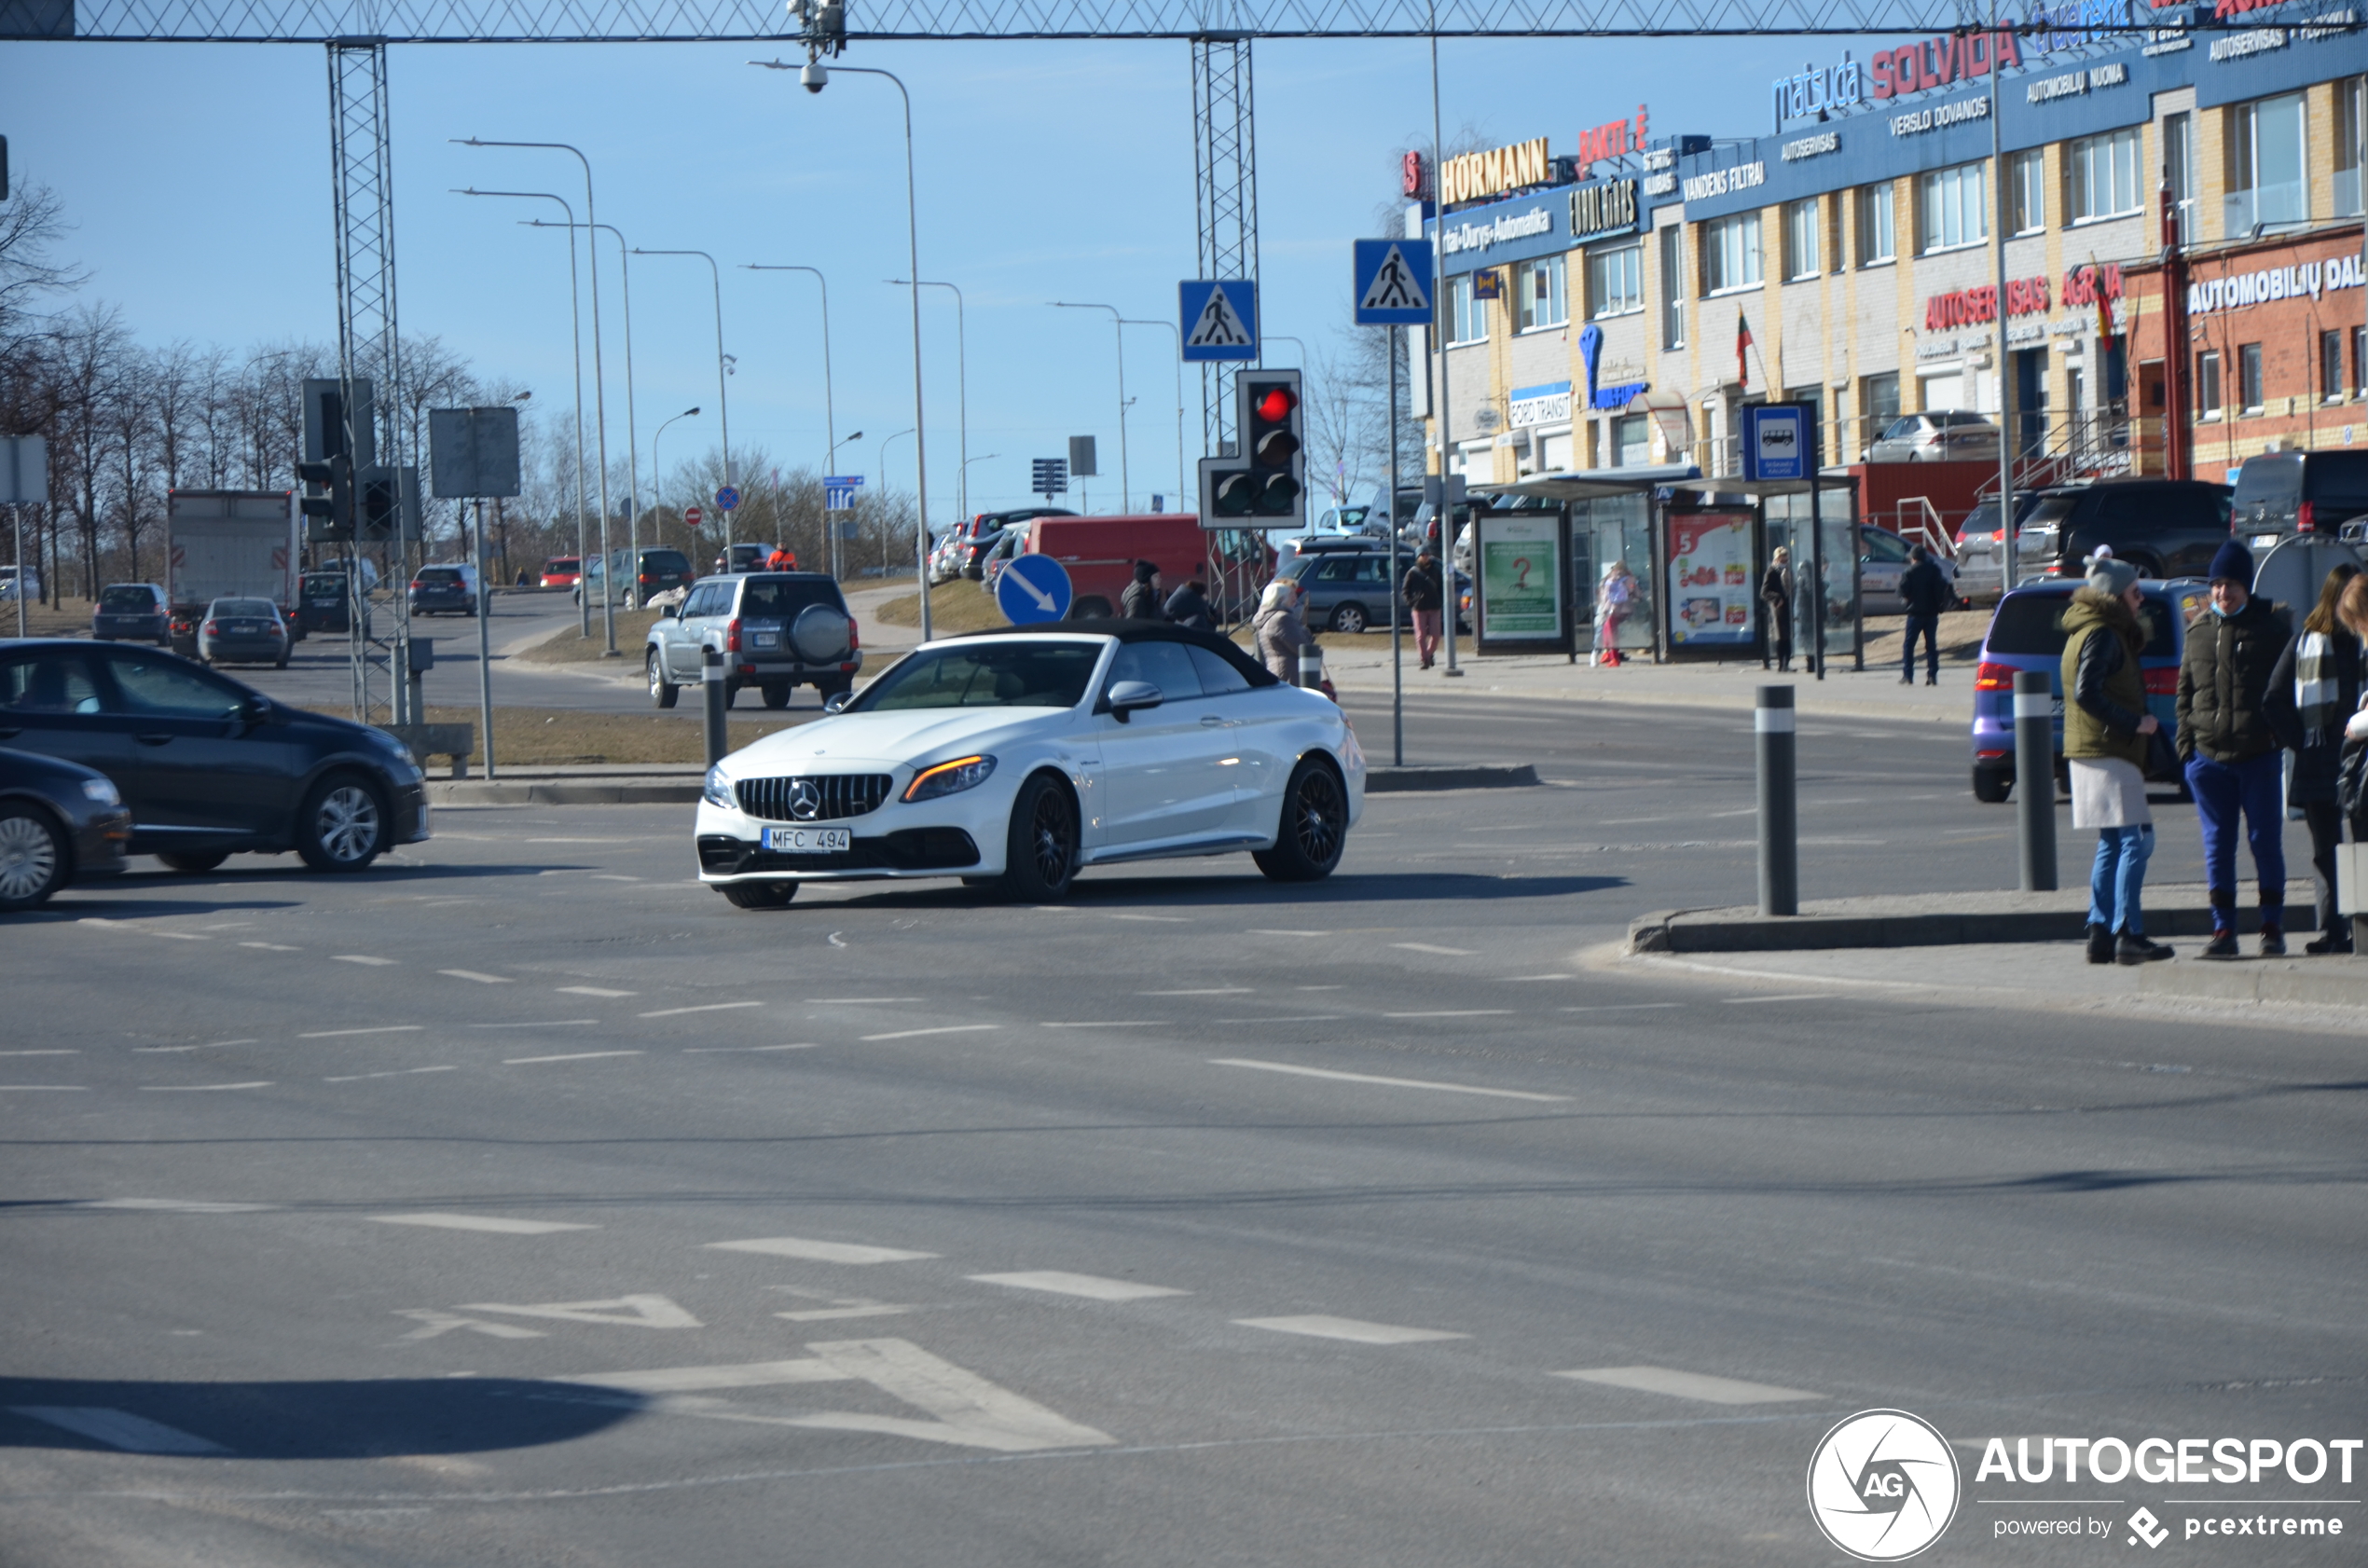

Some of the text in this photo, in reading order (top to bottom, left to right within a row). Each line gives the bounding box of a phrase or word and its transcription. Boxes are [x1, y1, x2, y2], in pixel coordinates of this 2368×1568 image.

[1872, 19, 2020, 100] SOLVIDA
[2210, 27, 2287, 62] AUTOSERVISAS
[1772, 49, 1862, 120] matsuda
[2090, 62, 2126, 89] NUOMA
[1890, 96, 1989, 137] VERSLO DOVANOS
[1781, 131, 1838, 162] AUTOSERVISAS
[1441, 136, 1549, 205] HÖRMANN
[1683, 160, 1765, 202] VANDENS FILTRAI
[1925, 276, 2048, 330] AUTOSERISAS
[2187, 262, 2322, 315] AUTOMOBILIŲ
[1512, 403, 1535, 424] FORD
[1536, 395, 1570, 420] TRANSIT
[772, 831, 805, 847] MFC
[817, 832, 846, 847] 494
